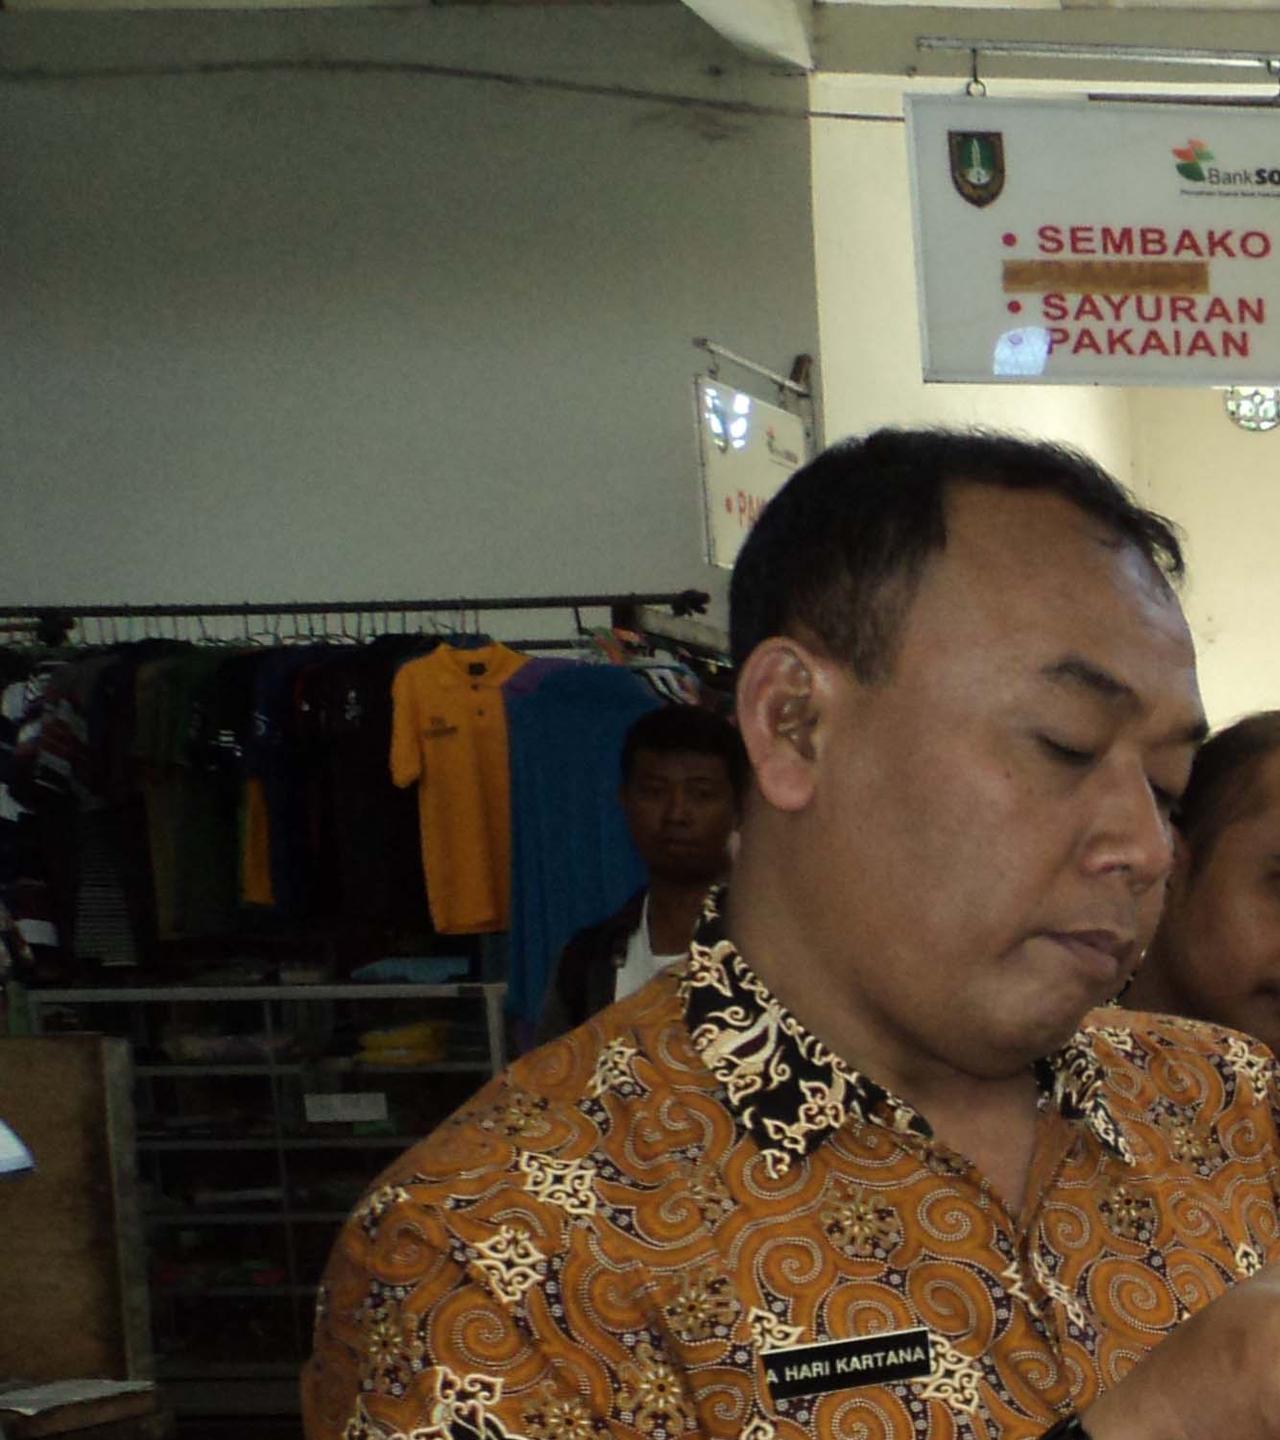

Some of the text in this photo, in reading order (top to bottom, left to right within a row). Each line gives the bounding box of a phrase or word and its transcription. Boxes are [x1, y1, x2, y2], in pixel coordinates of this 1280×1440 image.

[1037, 225, 1272, 259] SEMBAKO
[1042, 293, 1267, 325] SAYURAN
[1046, 328, 1251, 358] PAKAIAN
[784, 1360, 831, 1382] HARI
[835, 1346, 926, 1375] KARTANA
